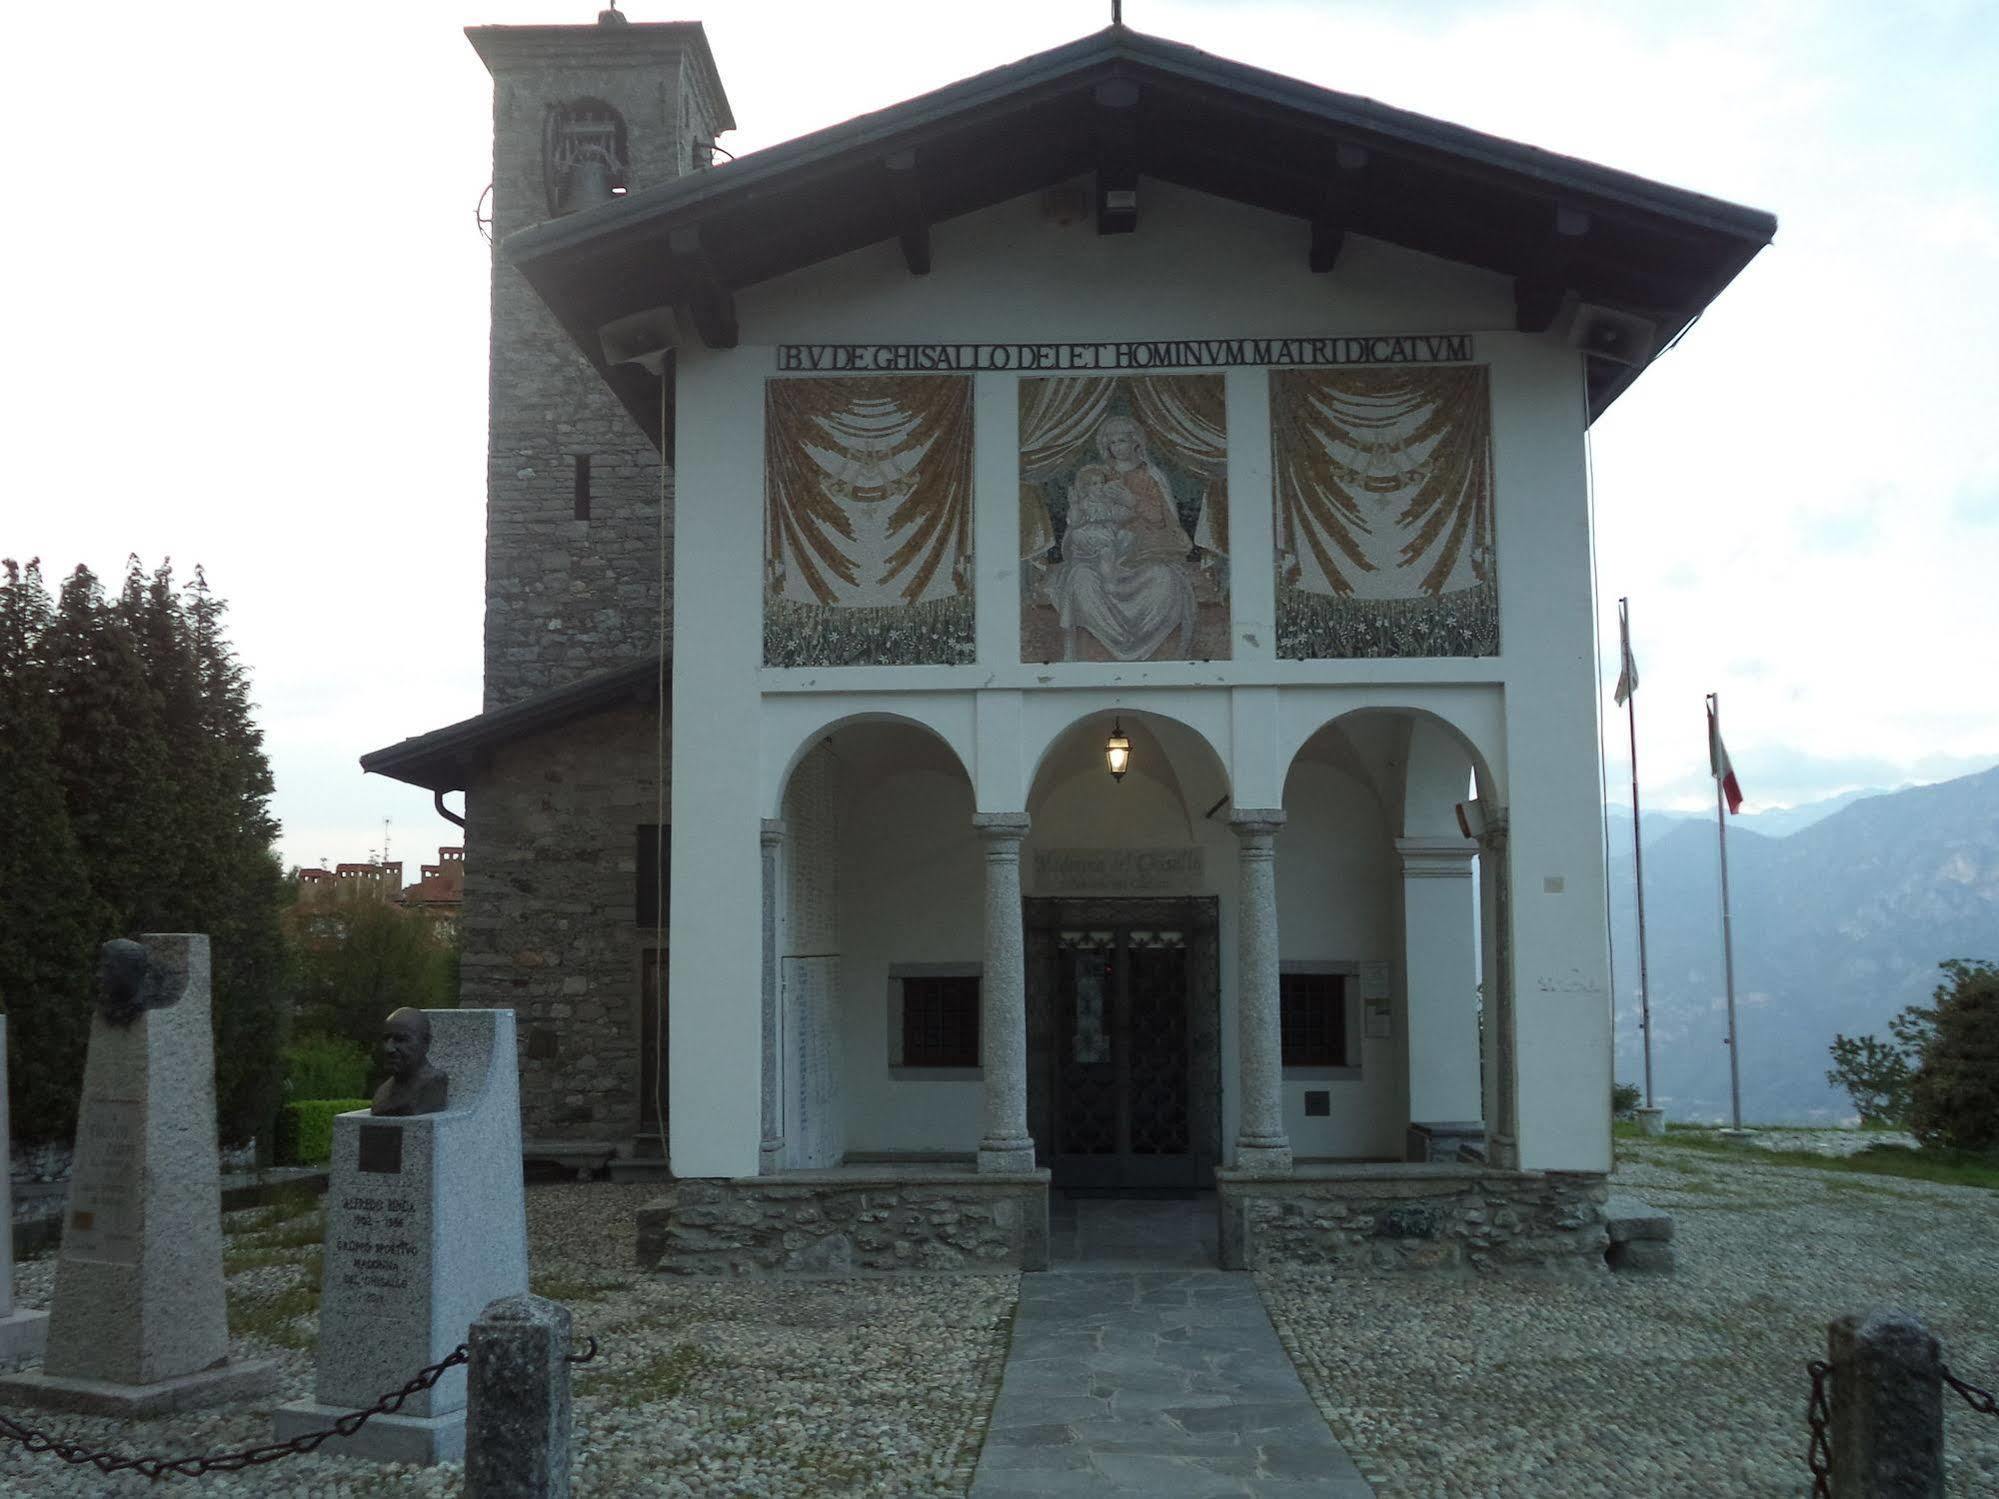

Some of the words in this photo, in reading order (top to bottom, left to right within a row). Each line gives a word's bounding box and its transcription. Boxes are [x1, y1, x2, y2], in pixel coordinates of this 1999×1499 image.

[874, 344, 1010, 369] GHISALLO
[1114, 340, 1244, 368] HOMINVM
[1252, 338, 1338, 365] MATRI
[1346, 335, 1467, 363] DICATVM
